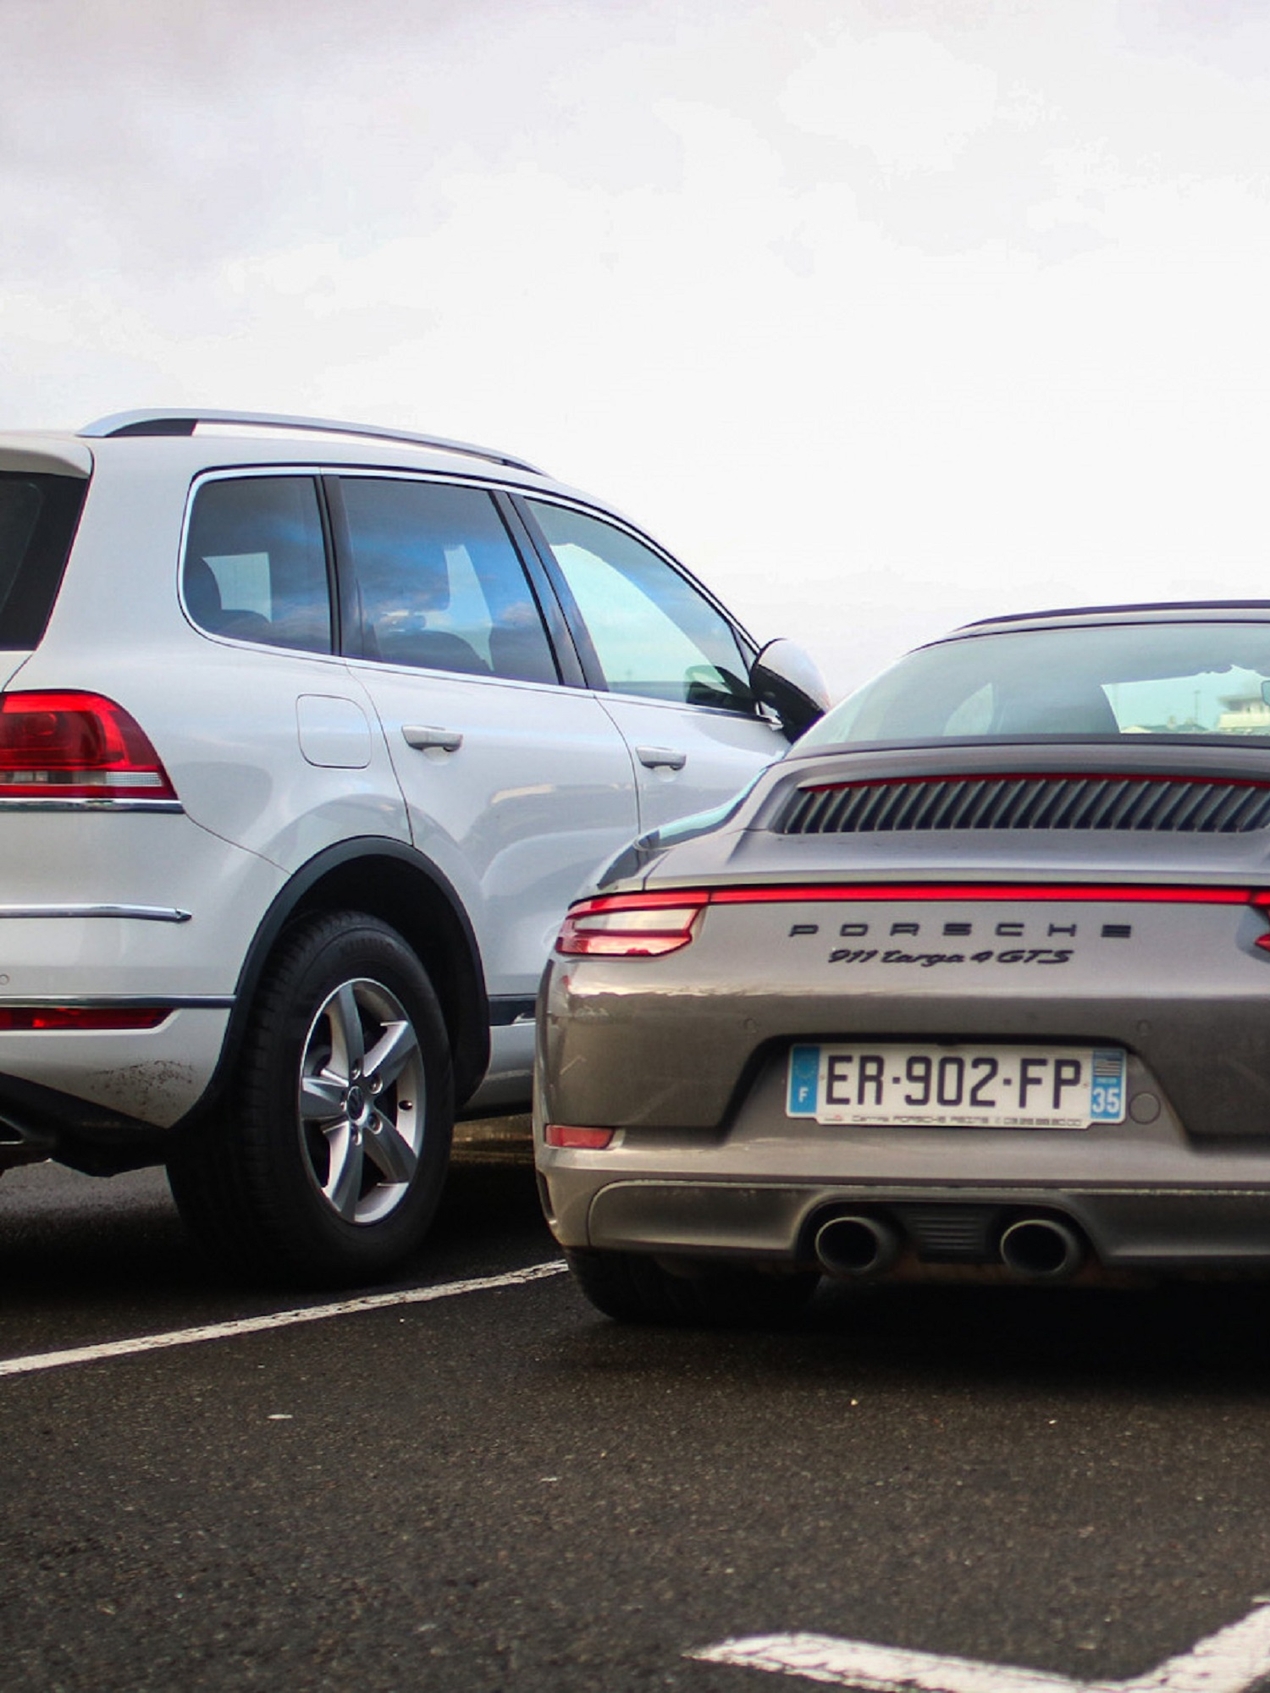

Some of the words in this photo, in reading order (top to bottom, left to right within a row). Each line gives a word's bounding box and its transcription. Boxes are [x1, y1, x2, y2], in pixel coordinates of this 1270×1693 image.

[788, 923, 1132, 938] PORSCHE
[828, 949, 877, 963] 911
[881, 949, 965, 967] targa
[970, 951, 993, 963] 4
[996, 949, 1074, 964] GTS
[799, 1087, 809, 1103] F
[1092, 1086, 1120, 1114] 35
